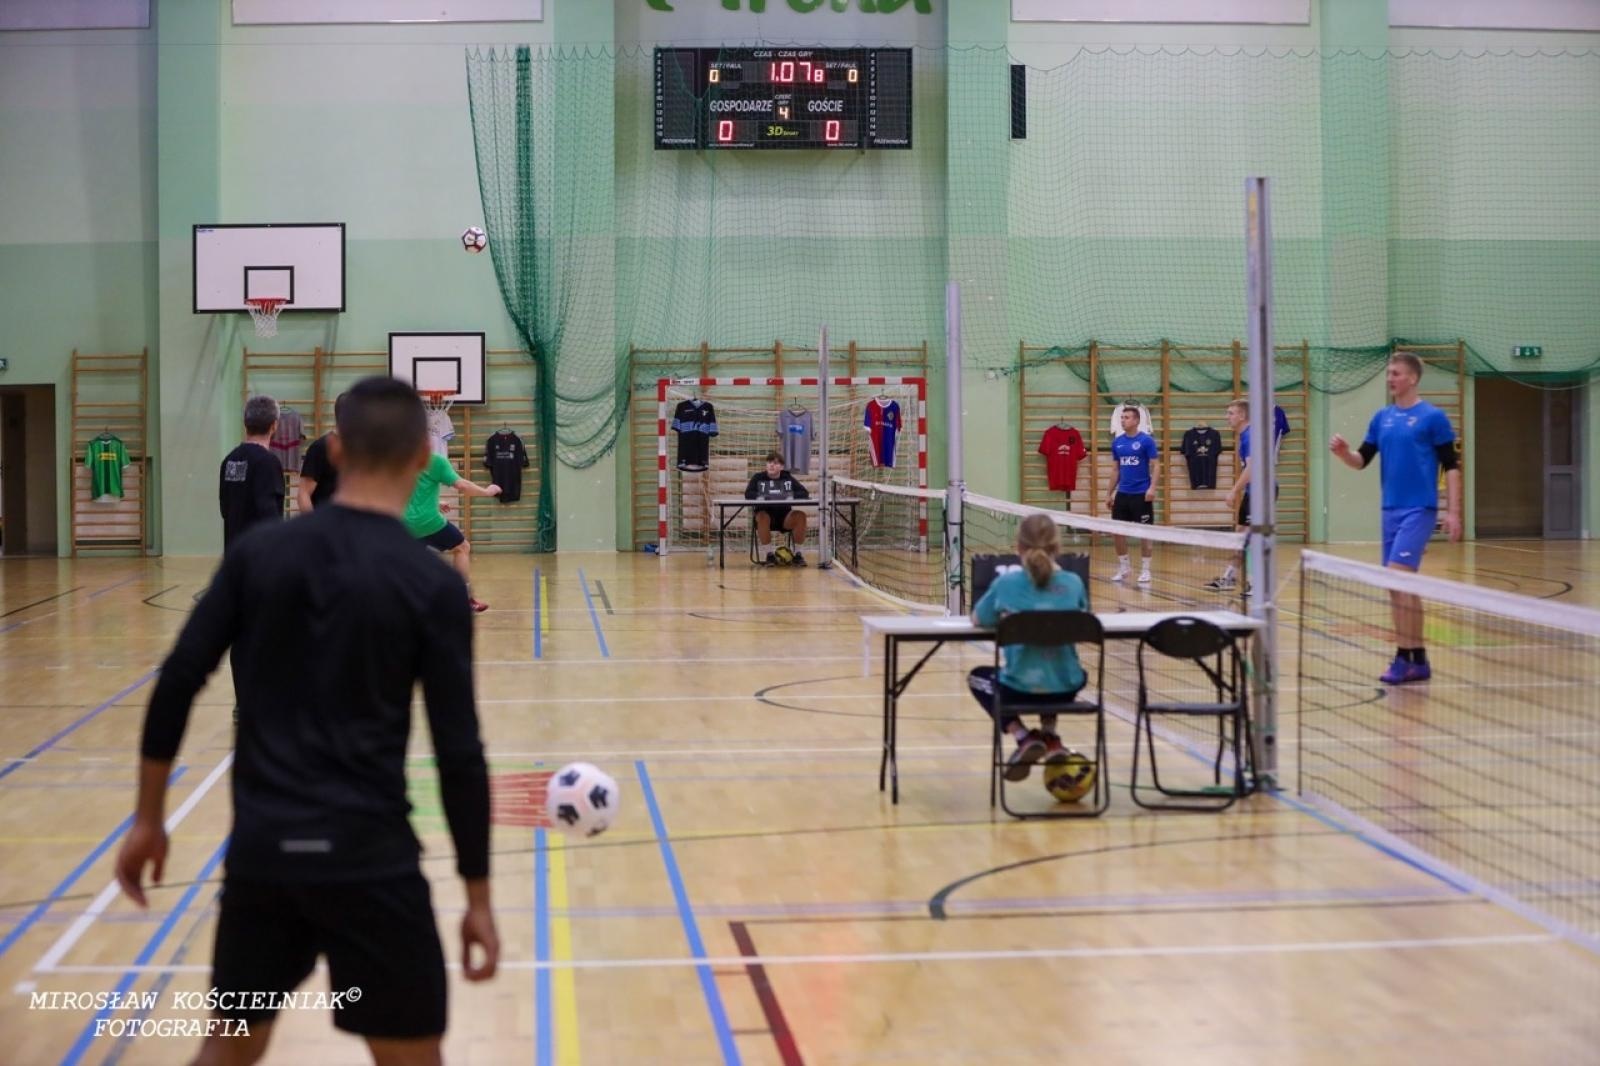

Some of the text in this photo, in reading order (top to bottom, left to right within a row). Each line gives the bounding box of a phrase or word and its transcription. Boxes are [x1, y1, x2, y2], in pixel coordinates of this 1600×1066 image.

[709, 69, 719, 82] 0
[848, 69, 858, 82] 0
[709, 100, 773, 112] GOSPODARZE
[807, 97, 843, 112] GOŚCIE
[779, 106, 789, 120] 4
[719, 120, 733, 141] 0
[825, 120, 840, 141] 0
